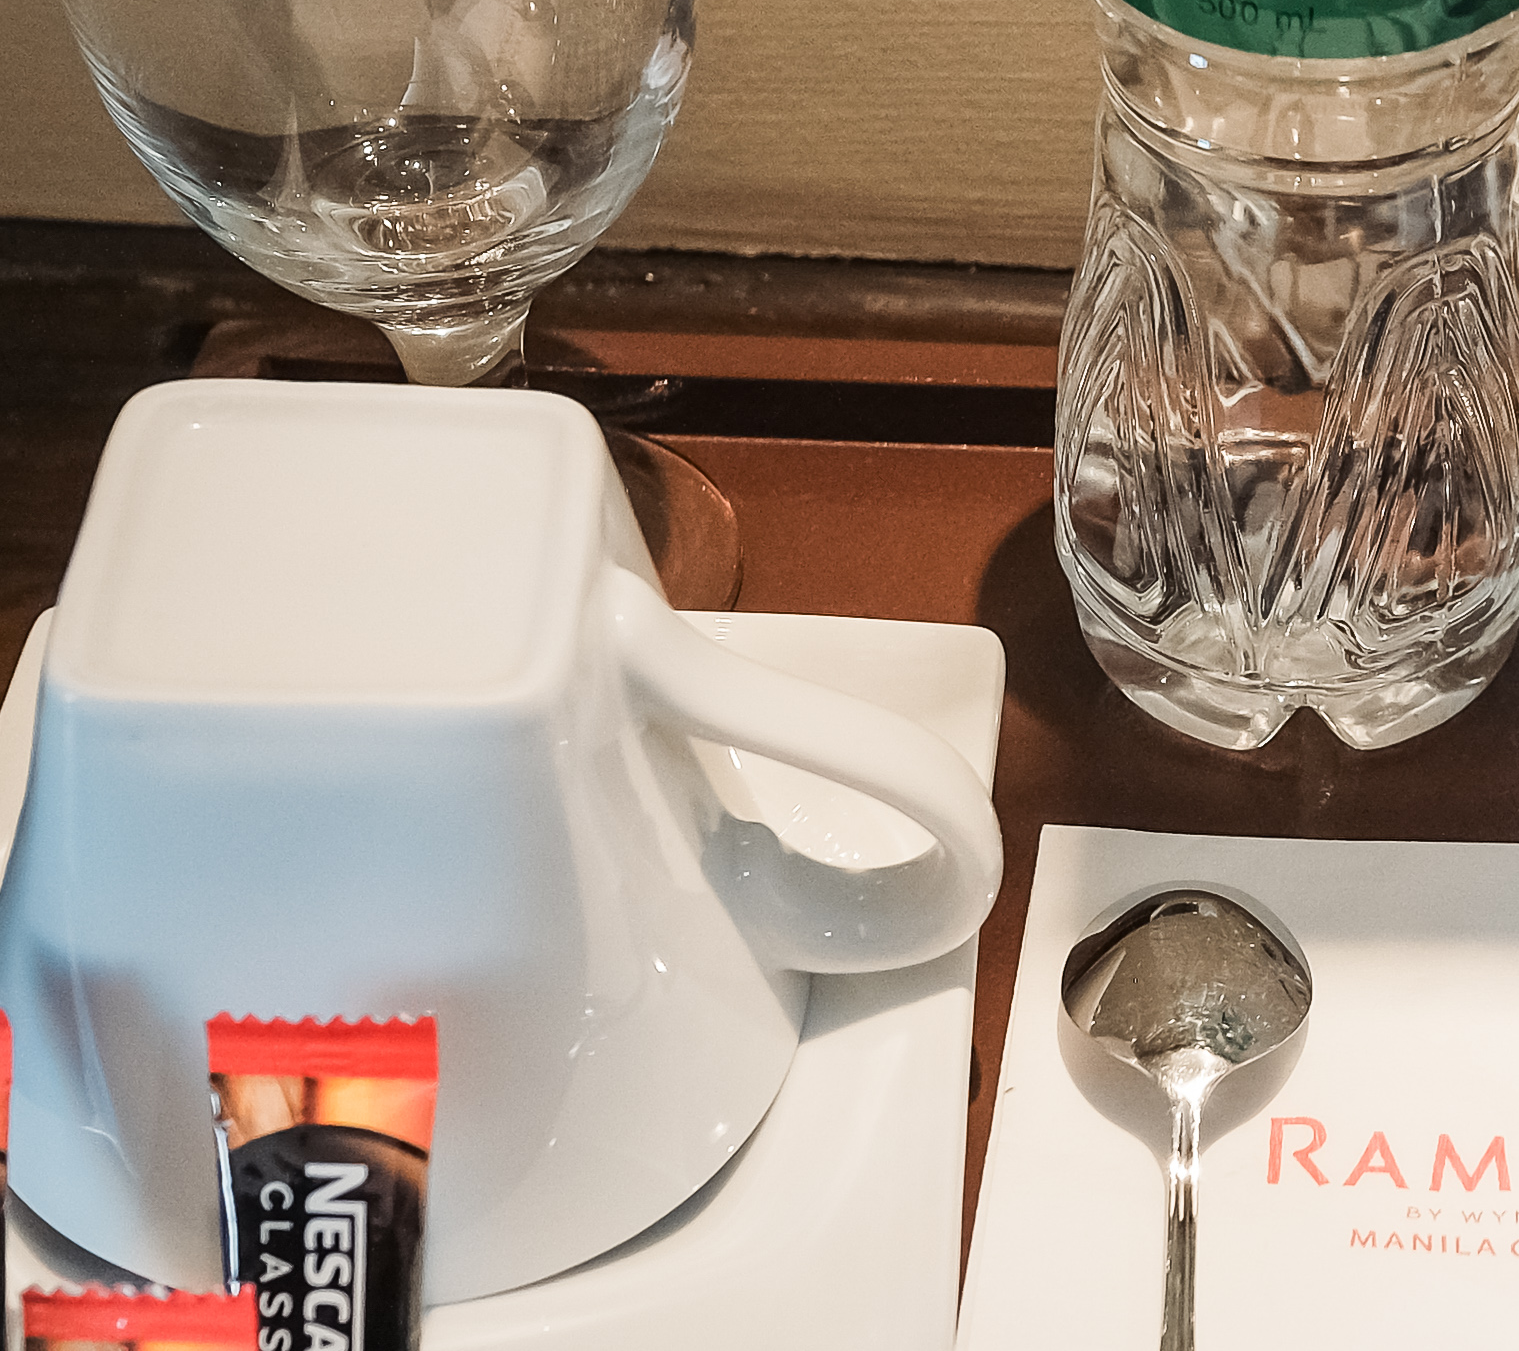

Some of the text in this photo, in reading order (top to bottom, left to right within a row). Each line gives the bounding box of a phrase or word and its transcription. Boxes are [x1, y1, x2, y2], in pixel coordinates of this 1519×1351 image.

[1276, 5, 1327, 35] mL
[1405, 1206, 1443, 1221] BY
[1349, 1228, 1498, 1256] MANILA
